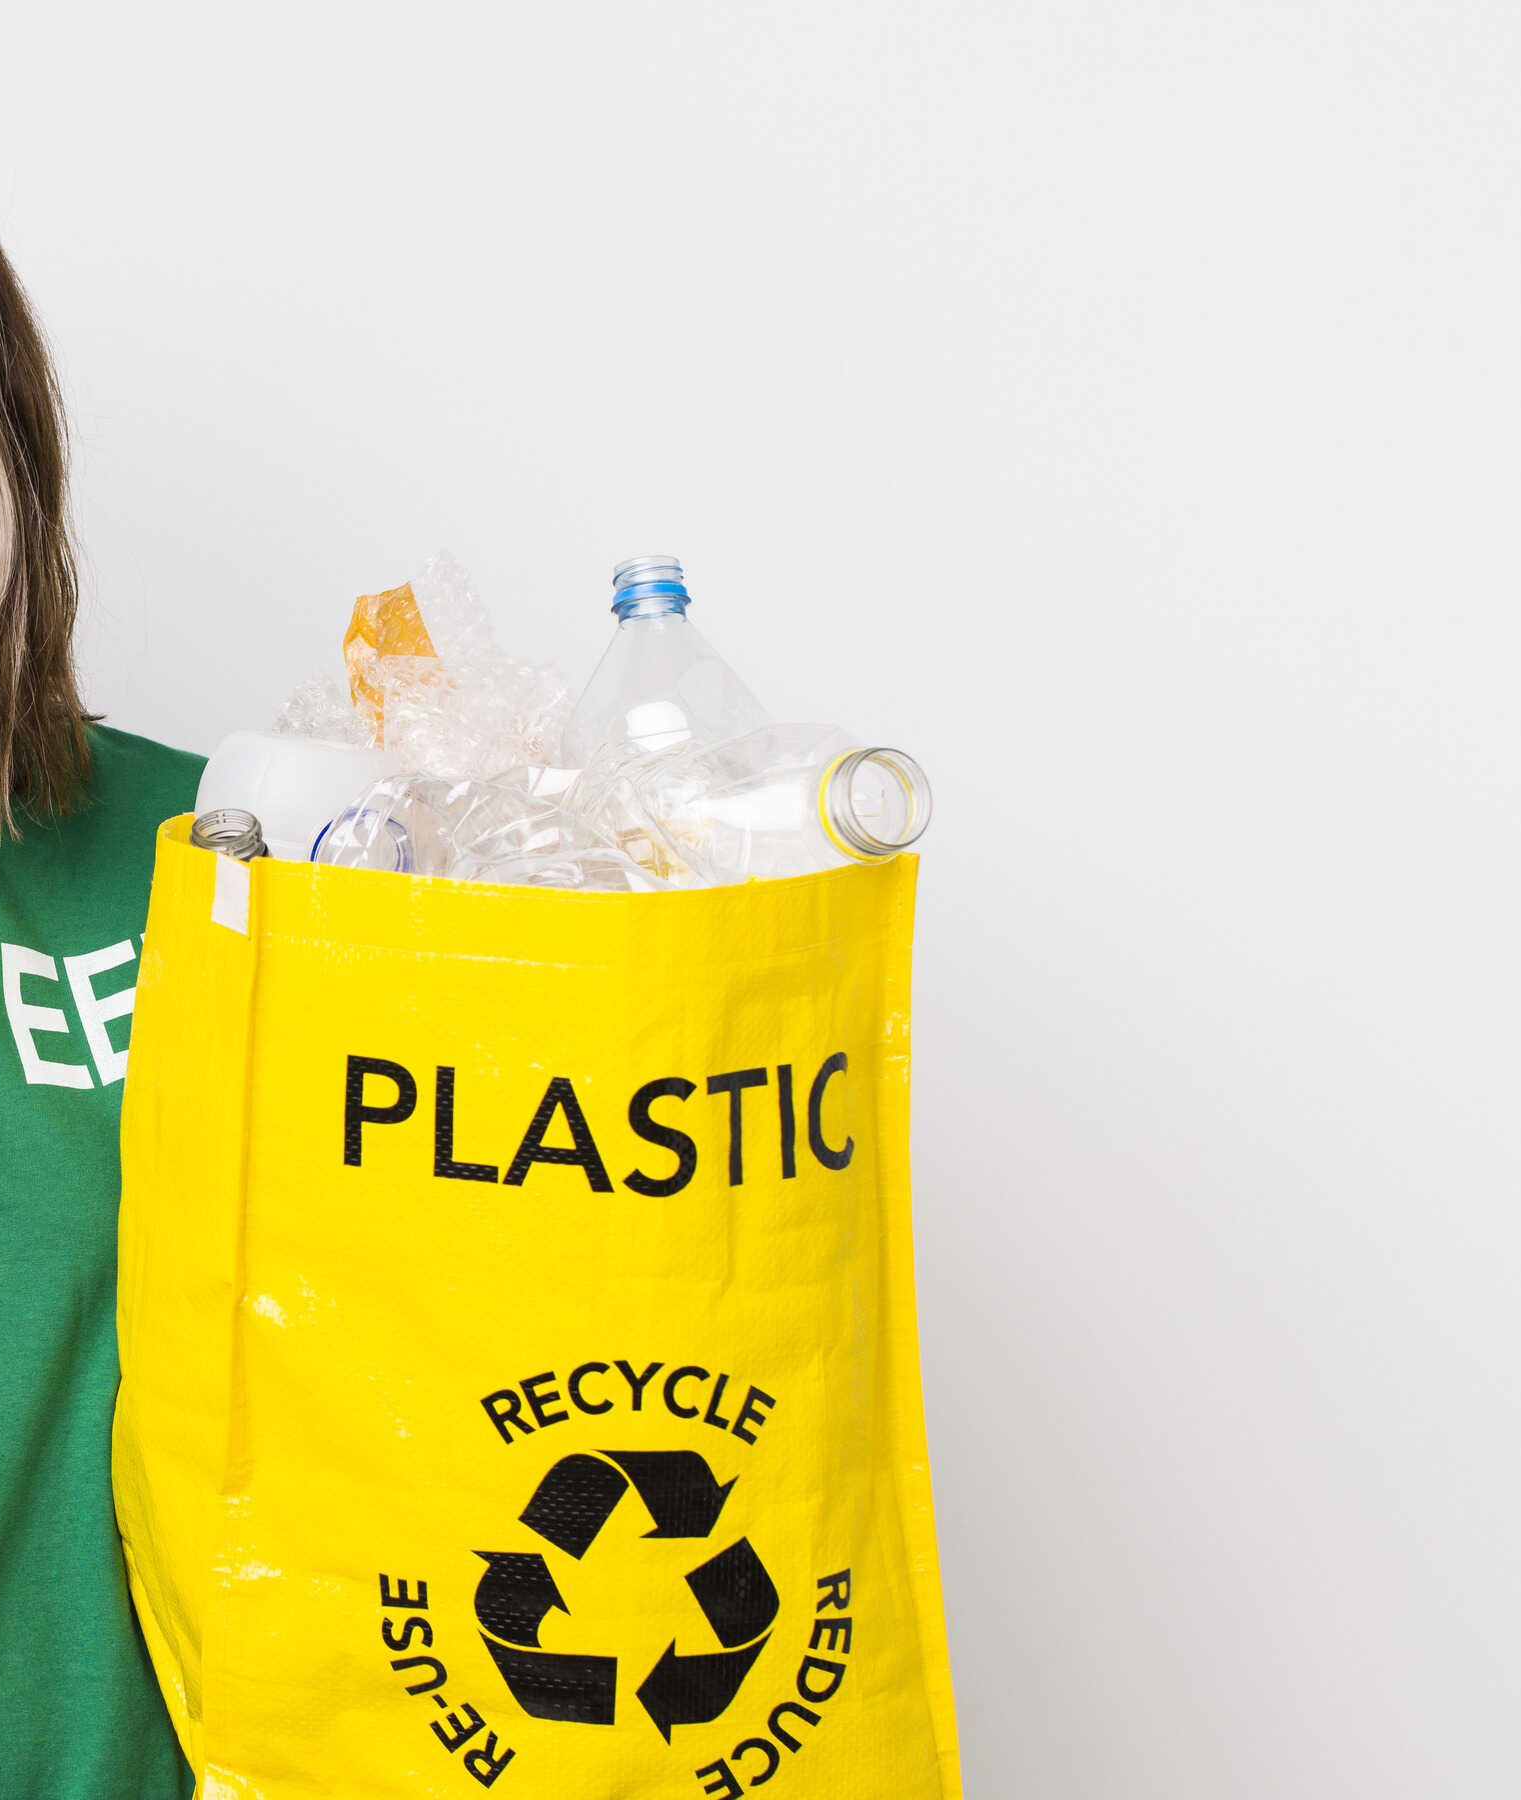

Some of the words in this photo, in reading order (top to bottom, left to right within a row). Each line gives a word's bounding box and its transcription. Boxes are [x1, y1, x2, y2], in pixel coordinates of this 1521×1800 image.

[343, 1052, 855, 1197] PLASTIC
[480, 1360, 776, 1445] RECYCLE
[379, 1572, 516, 1788] RE-USE
[695, 1568, 853, 1800] REDUCE
